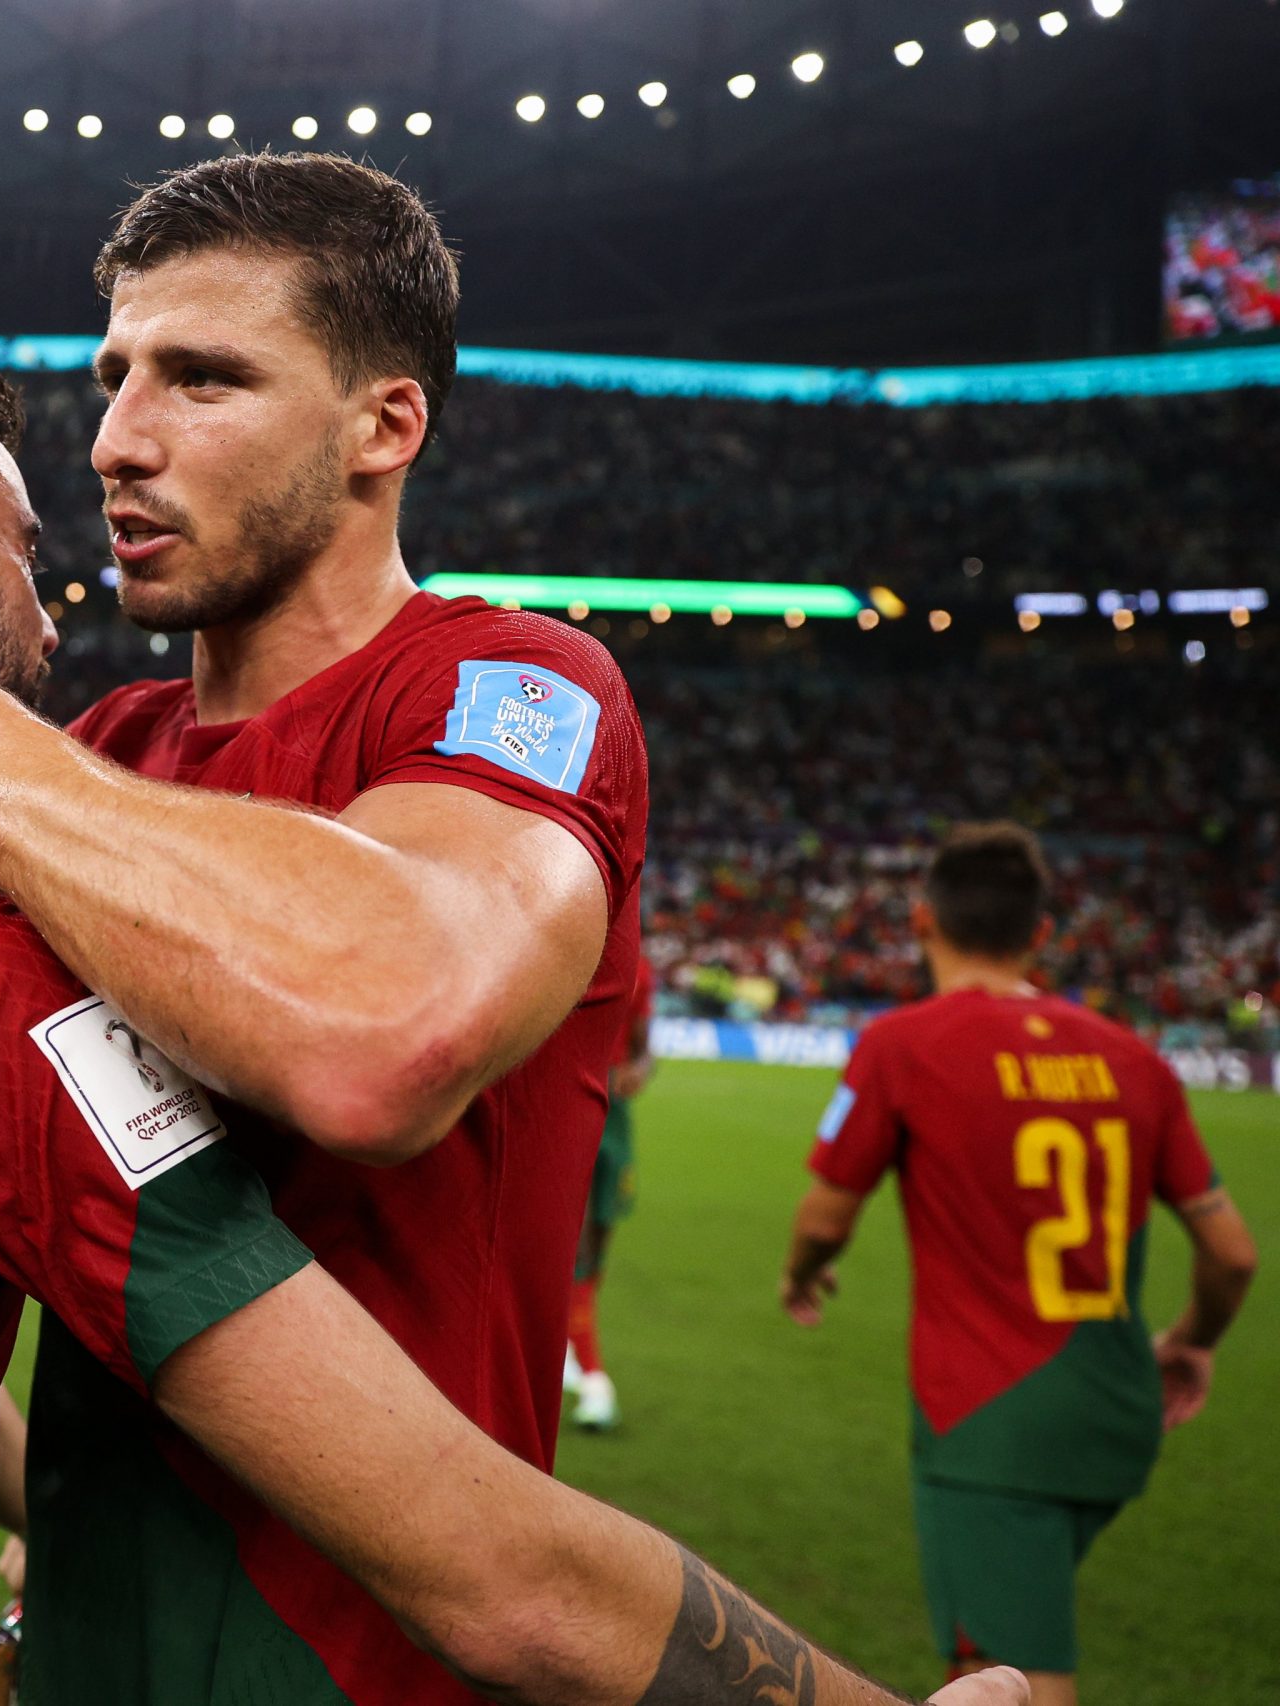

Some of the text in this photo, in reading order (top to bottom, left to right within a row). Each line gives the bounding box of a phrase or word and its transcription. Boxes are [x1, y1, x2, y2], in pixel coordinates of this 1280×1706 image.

[496, 707, 554, 741] UNITES
[500, 696, 556, 726] FOOTBALL
[504, 736, 524, 756] FIFA
[514, 723, 549, 757] World
[125, 1113, 152, 1132] FIFA
[148, 1094, 183, 1117] WORLD
[1013, 1116, 1132, 1322] 21
